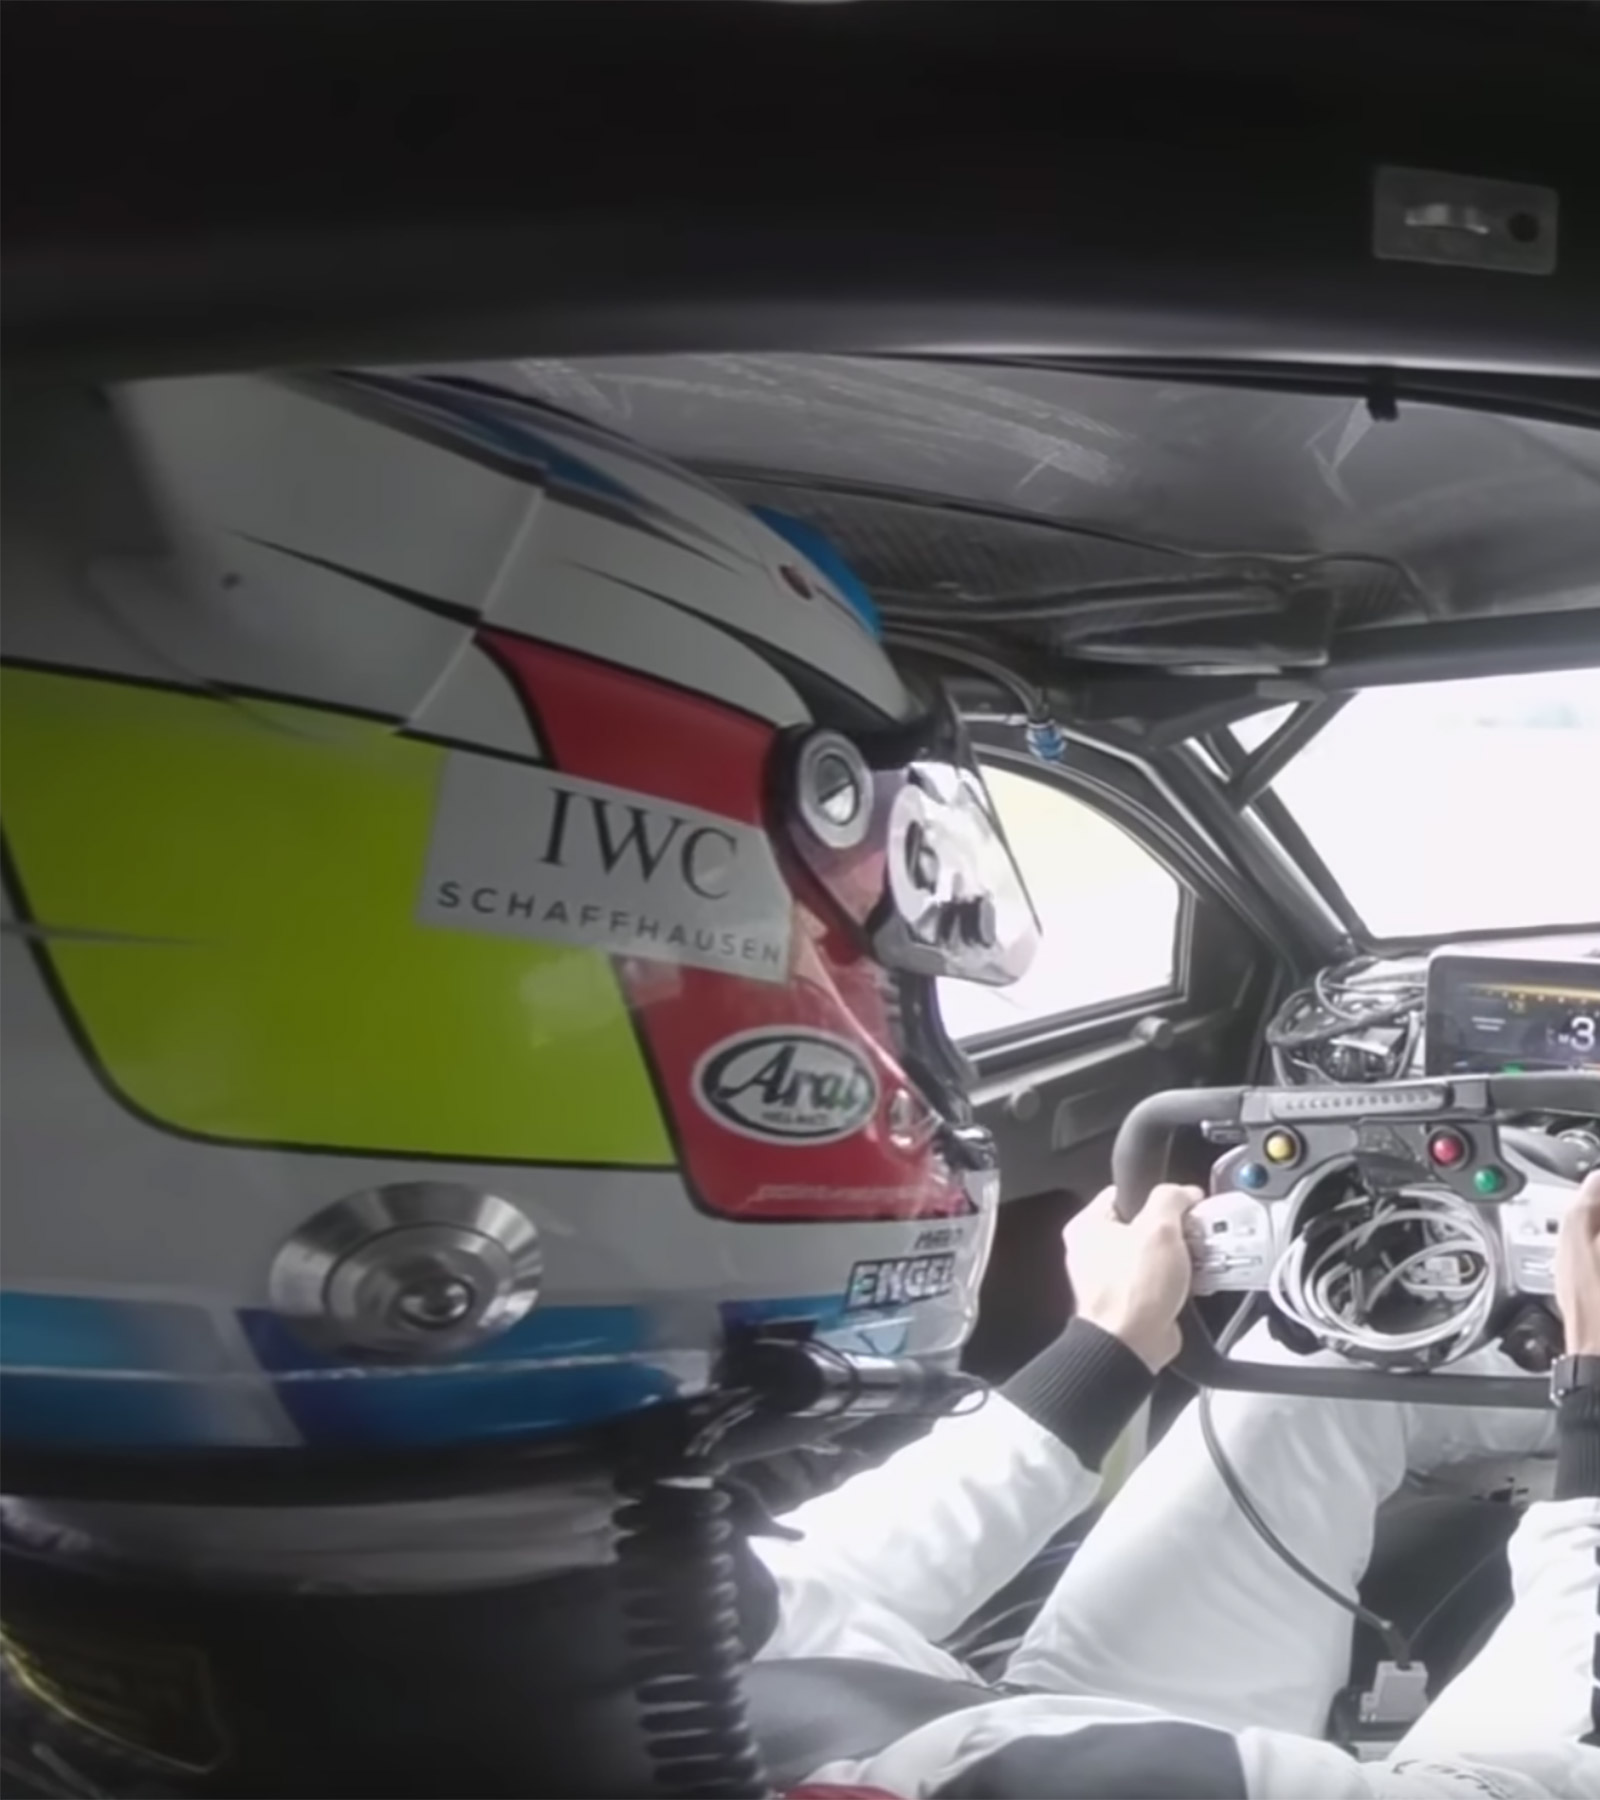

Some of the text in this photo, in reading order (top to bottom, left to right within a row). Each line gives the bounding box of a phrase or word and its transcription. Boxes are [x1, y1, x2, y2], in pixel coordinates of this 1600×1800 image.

[538, 787, 738, 900] IWC
[437, 880, 782, 964] SCHAFFHAUSEN
[1570, 1016, 1596, 1051] 3
[715, 1044, 856, 1110] Arai
